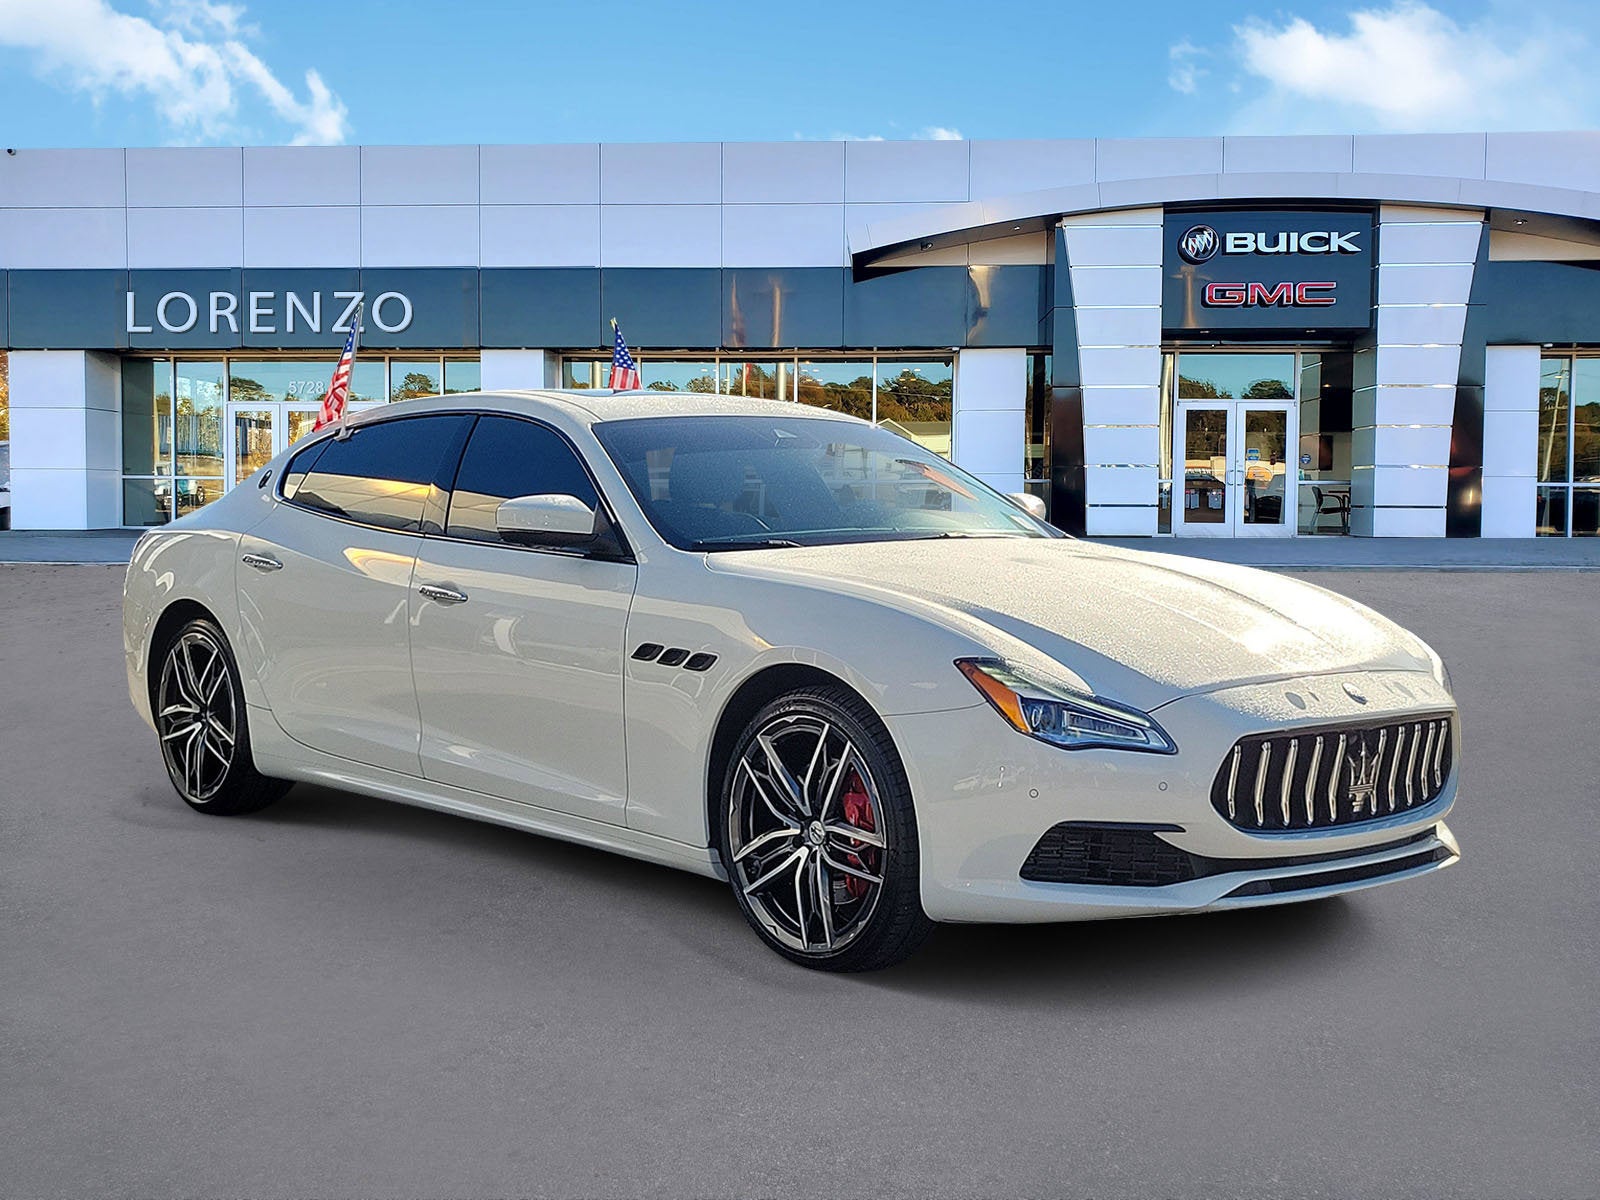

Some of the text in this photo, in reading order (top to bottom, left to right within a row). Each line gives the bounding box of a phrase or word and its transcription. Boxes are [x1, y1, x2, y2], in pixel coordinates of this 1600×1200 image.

[1225, 231, 1362, 253] BUICK
[1205, 282, 1337, 306] GMC
[126, 291, 414, 333] LORENZO
[288, 381, 325, 394] 5728
